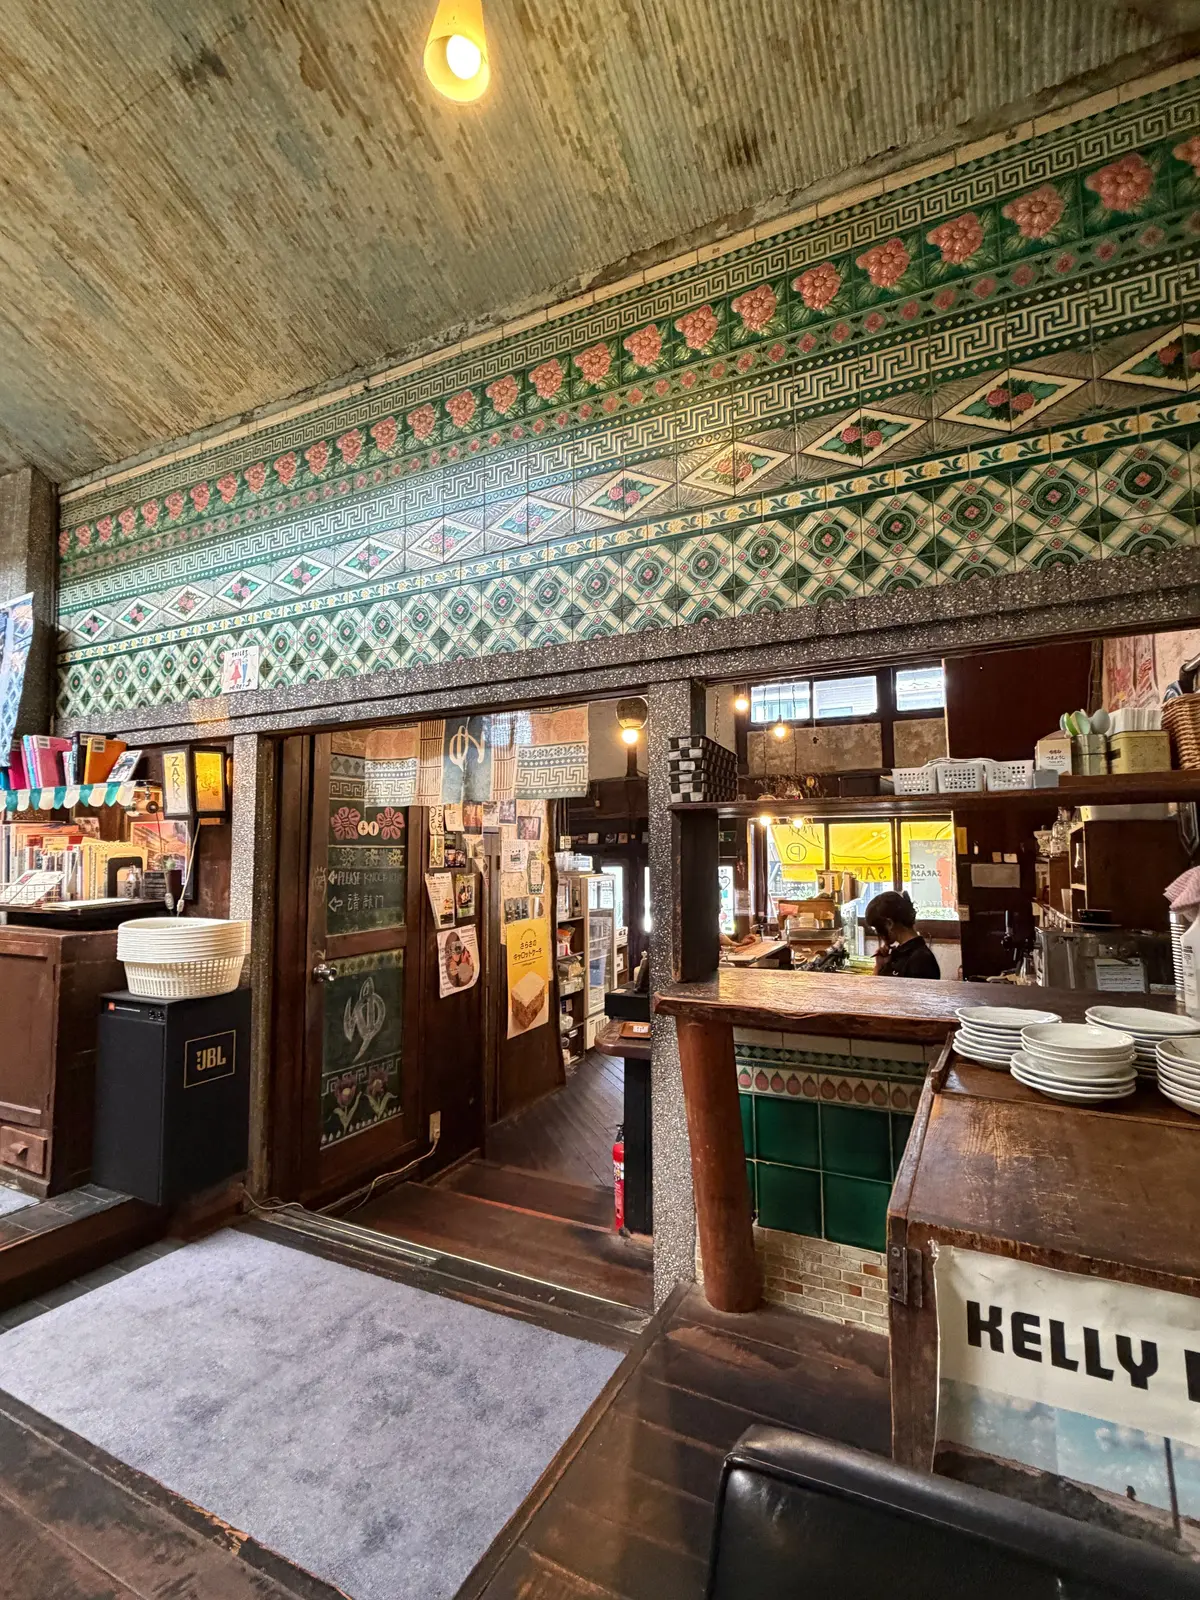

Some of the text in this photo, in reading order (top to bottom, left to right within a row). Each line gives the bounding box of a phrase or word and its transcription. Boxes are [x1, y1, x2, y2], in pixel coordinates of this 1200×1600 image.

[171, 756, 182, 808] ZAKK
[337, 871, 361, 886] PLEASE
[196, 1046, 227, 1072] JBL
[966, 1300, 1158, 1391] KELLY
